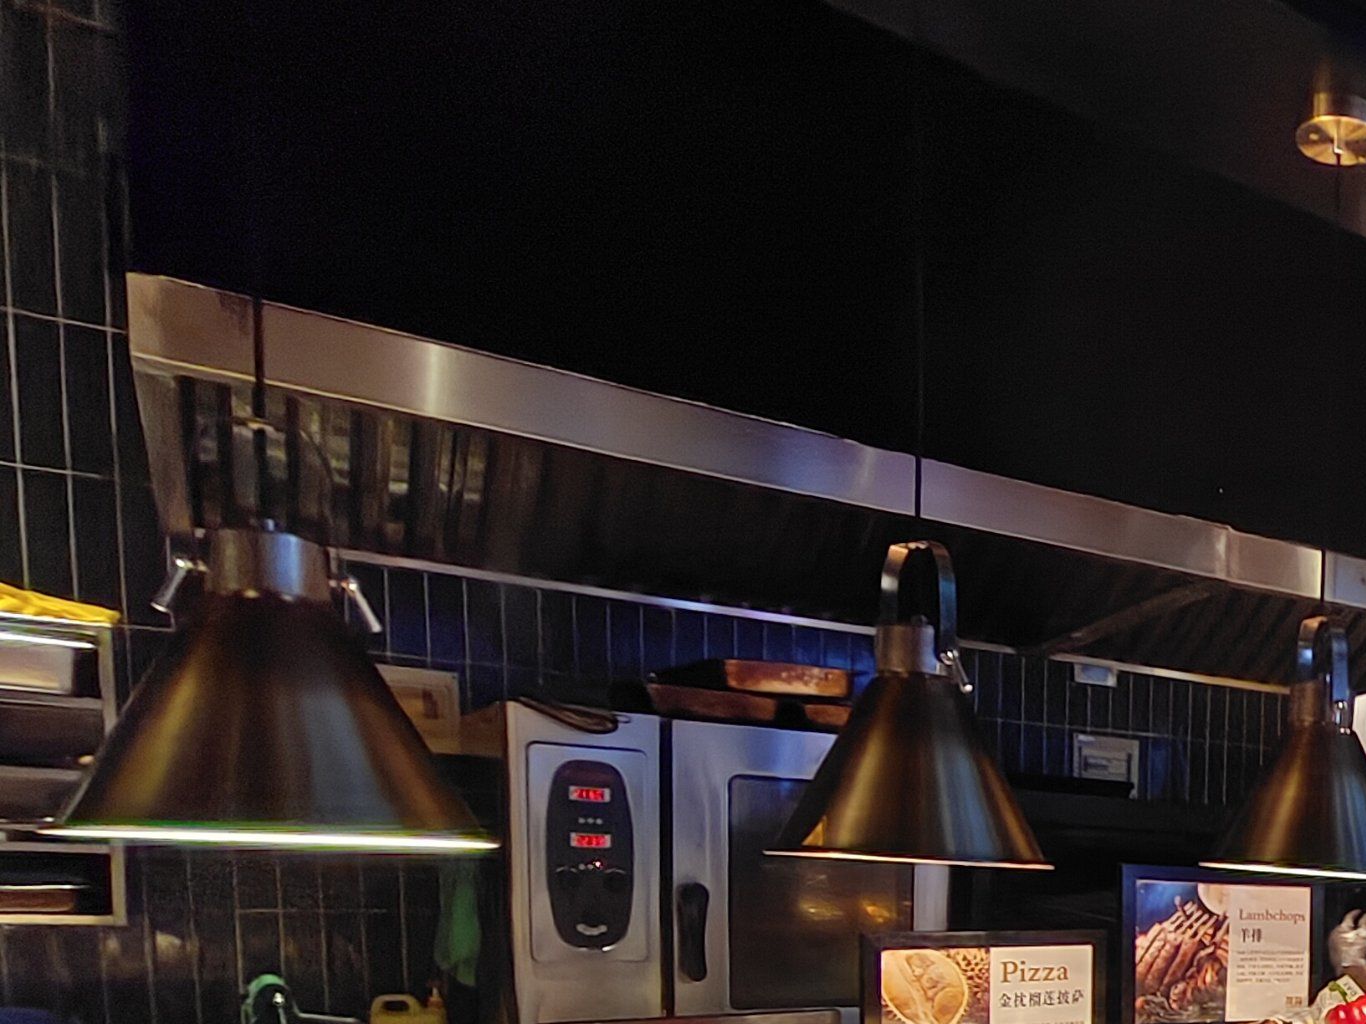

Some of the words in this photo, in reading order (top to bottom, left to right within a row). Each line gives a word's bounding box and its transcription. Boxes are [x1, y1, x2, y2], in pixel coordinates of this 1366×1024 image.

[1239, 908, 1306, 925] Lambchops
[1000, 960, 1069, 983] Pizza
[999, 989, 1084, 1008] 金枕榴莲披萨
